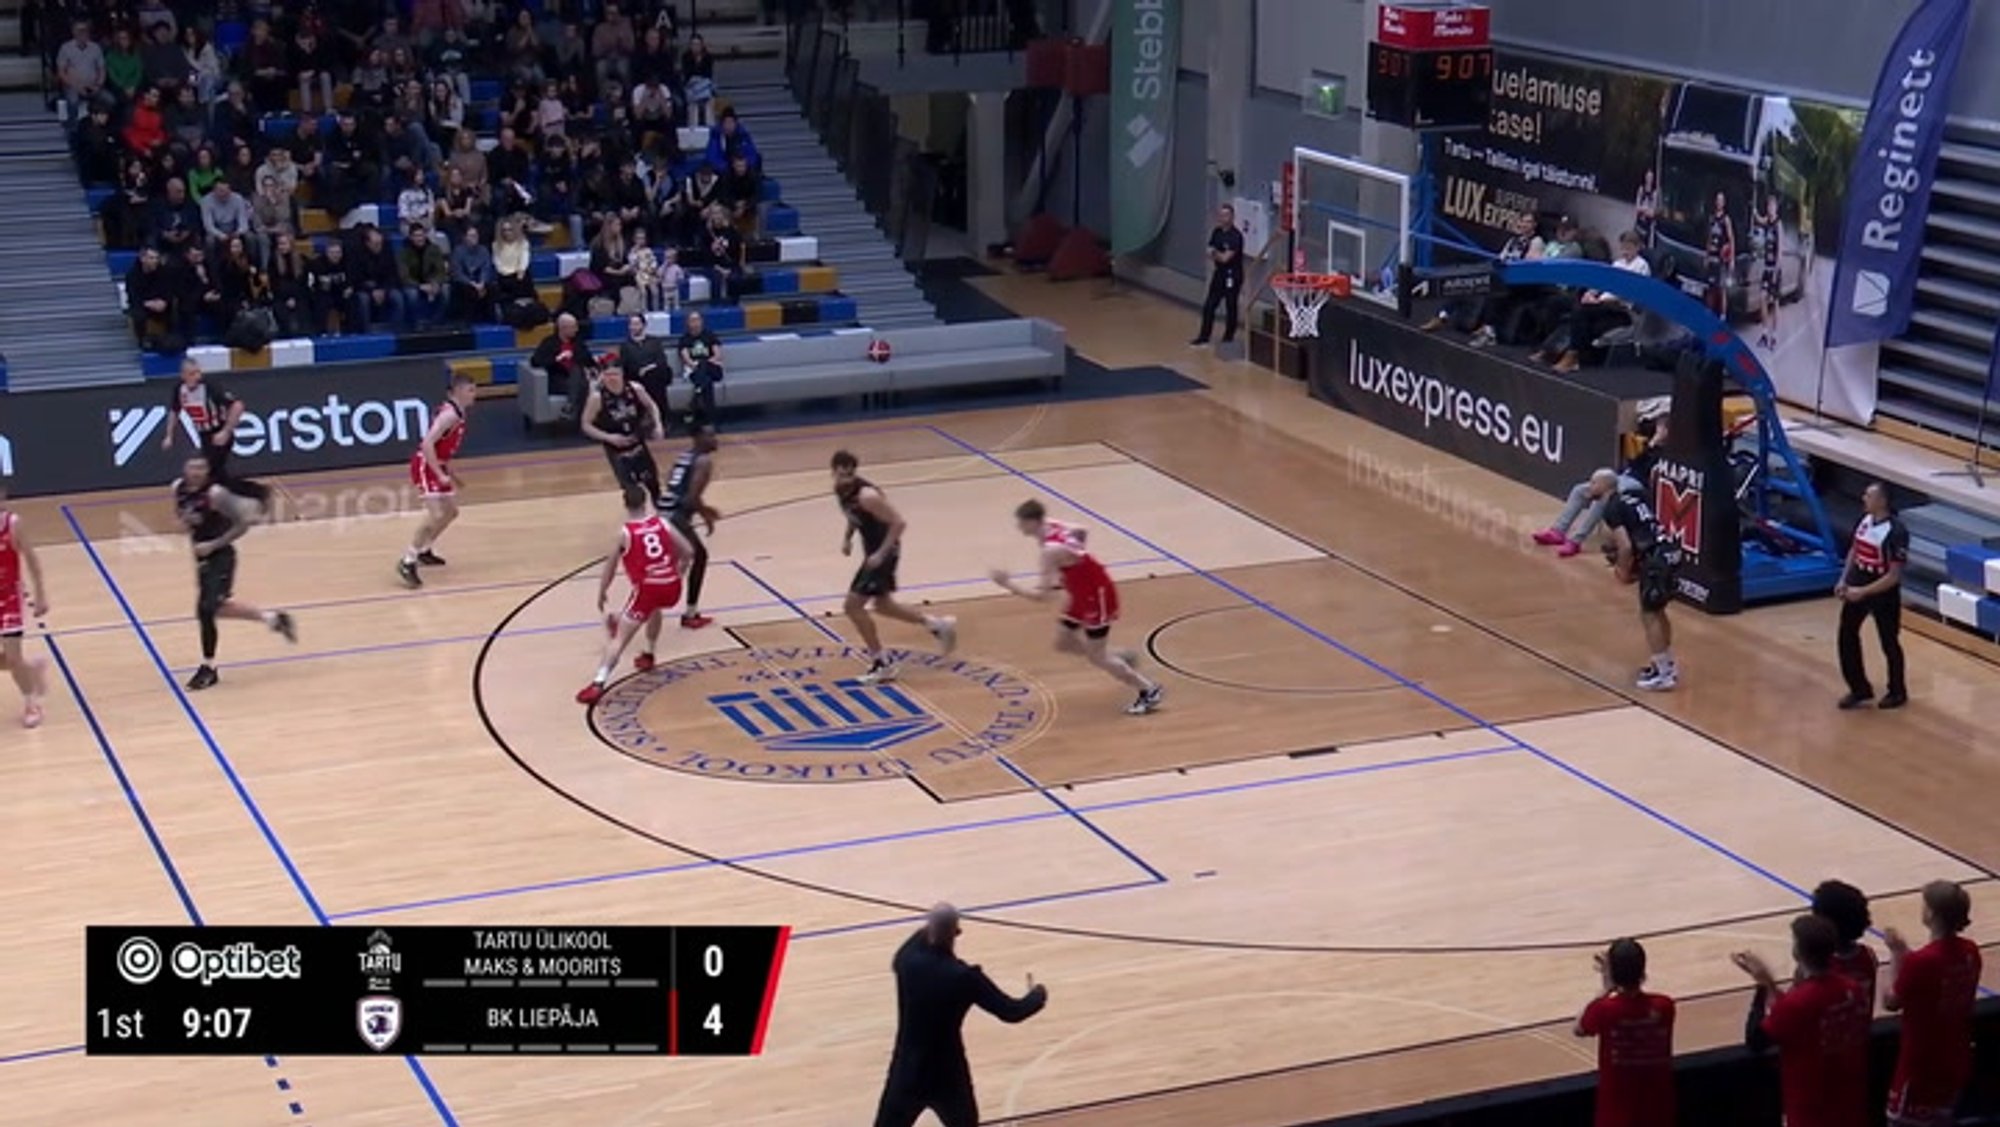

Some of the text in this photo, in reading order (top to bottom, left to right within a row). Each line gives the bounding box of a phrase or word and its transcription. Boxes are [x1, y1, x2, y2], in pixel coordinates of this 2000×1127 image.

[1491, 67, 1602, 116] uelamuse
[1862, 49, 1935, 251] Reginett
[1444, 175, 1487, 223] LUX
[1348, 338, 1564, 464] luxexpress.eu
[643, 532, 663, 559] 8
[748, 646, 1031, 700] UNIVERITAS
